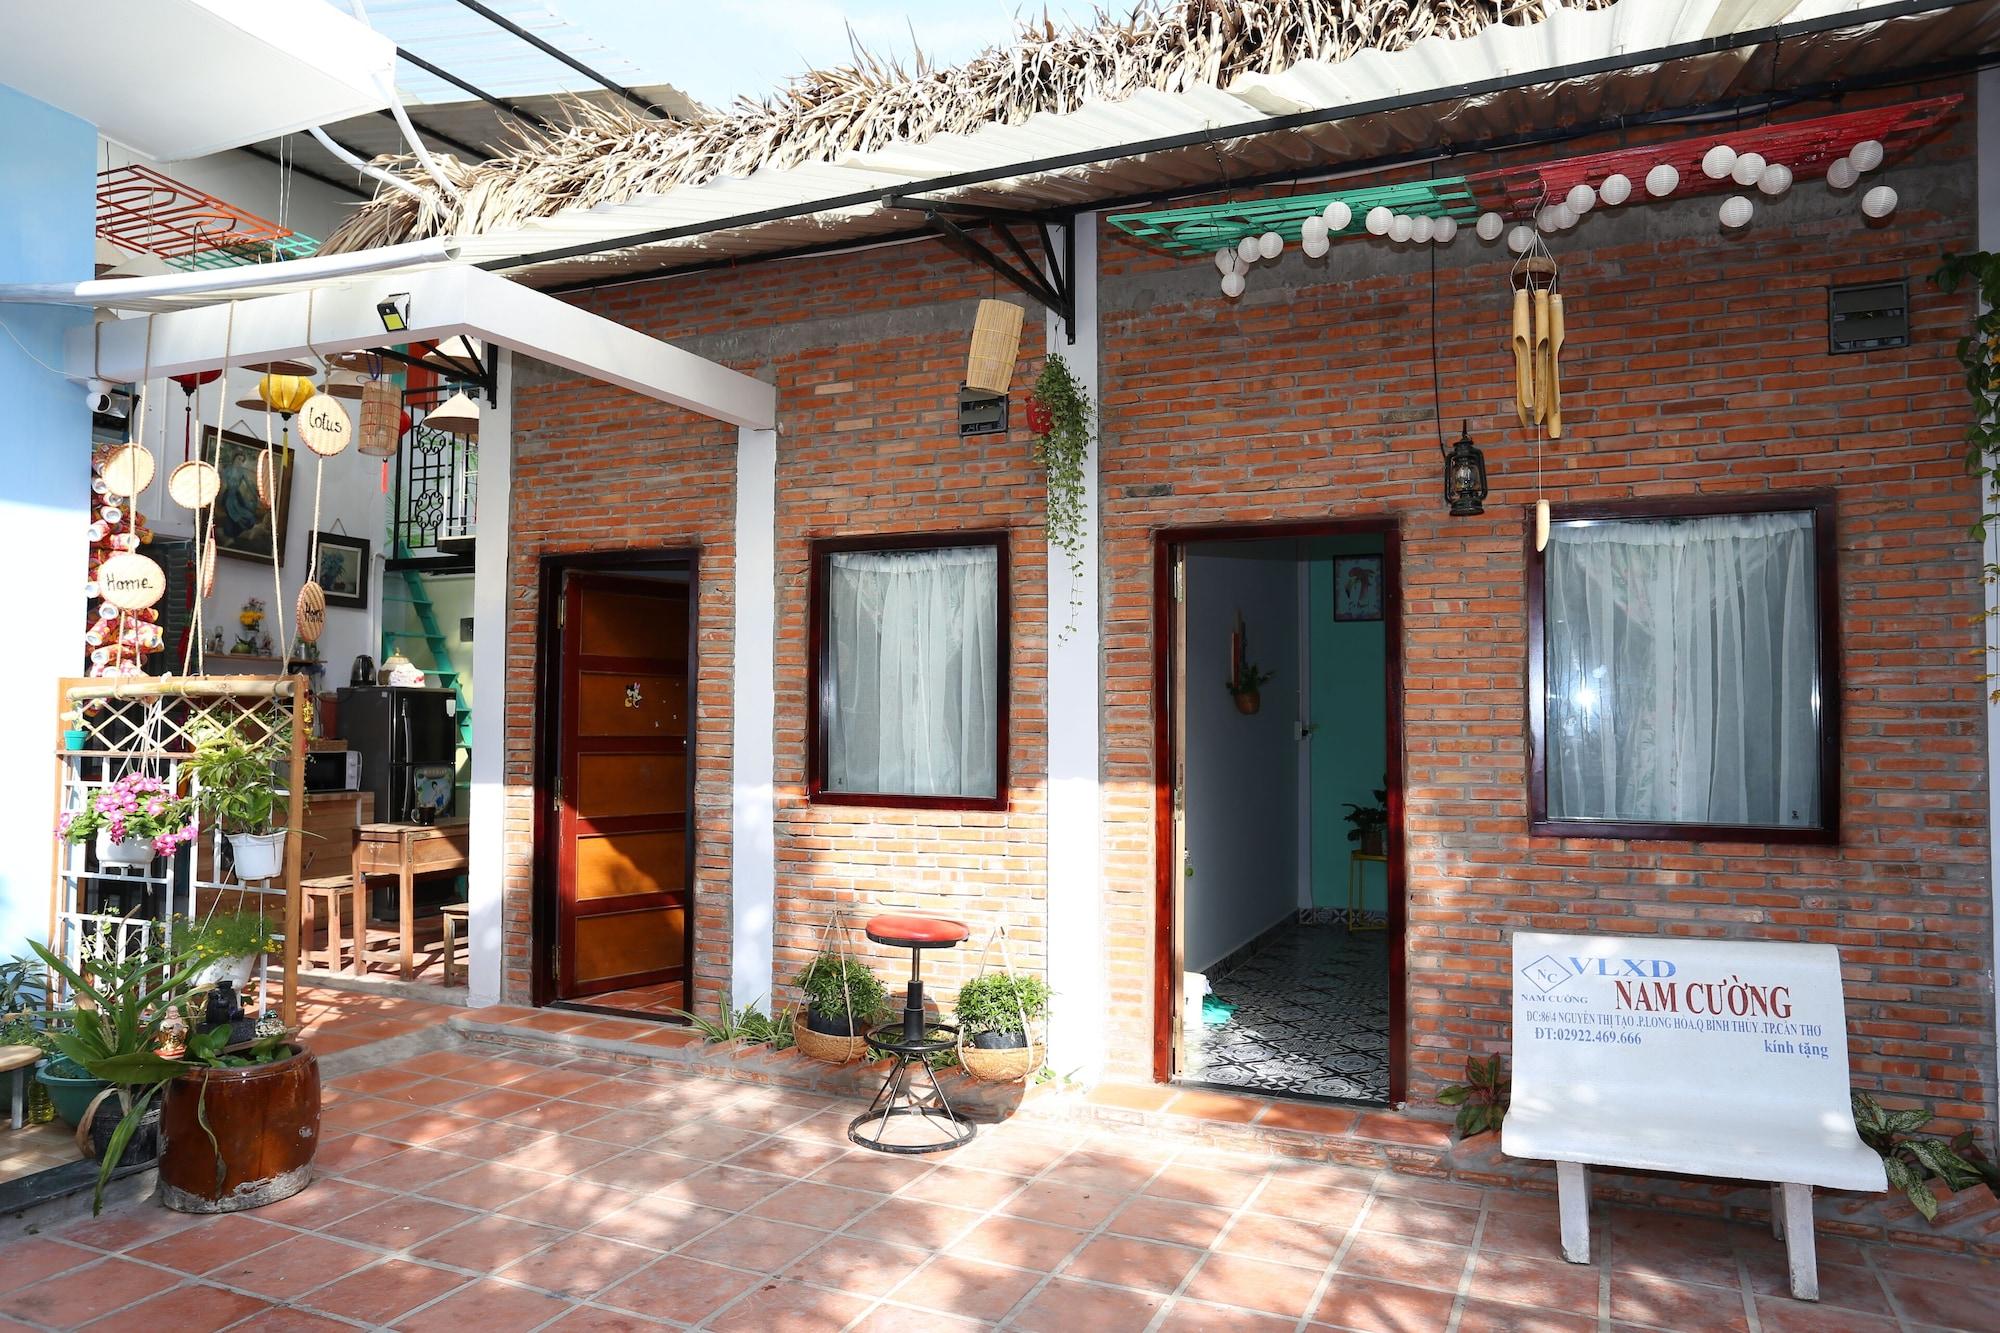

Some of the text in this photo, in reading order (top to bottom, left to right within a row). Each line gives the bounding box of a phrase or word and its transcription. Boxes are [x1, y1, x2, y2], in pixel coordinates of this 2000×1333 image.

[106, 572, 153, 592] Home
[1537, 968, 1558, 983] NC
[1568, 956, 1676, 978] VLXD
[1521, 993, 1545, 1002] NAM
[1615, 975, 1792, 1019] NAM CƯỜNG
[1597, 1013, 1613, 1028] THỊ
[1615, 1015, 1634, 1029] TẠO
[1706, 1016, 1729, 1031] BÌNH
[1800, 1024, 1822, 1037] THƠ
[1535, 1026, 1642, 1045] ĐT:02922.469.666
[1764, 1039, 1829, 1059] kính tặng
